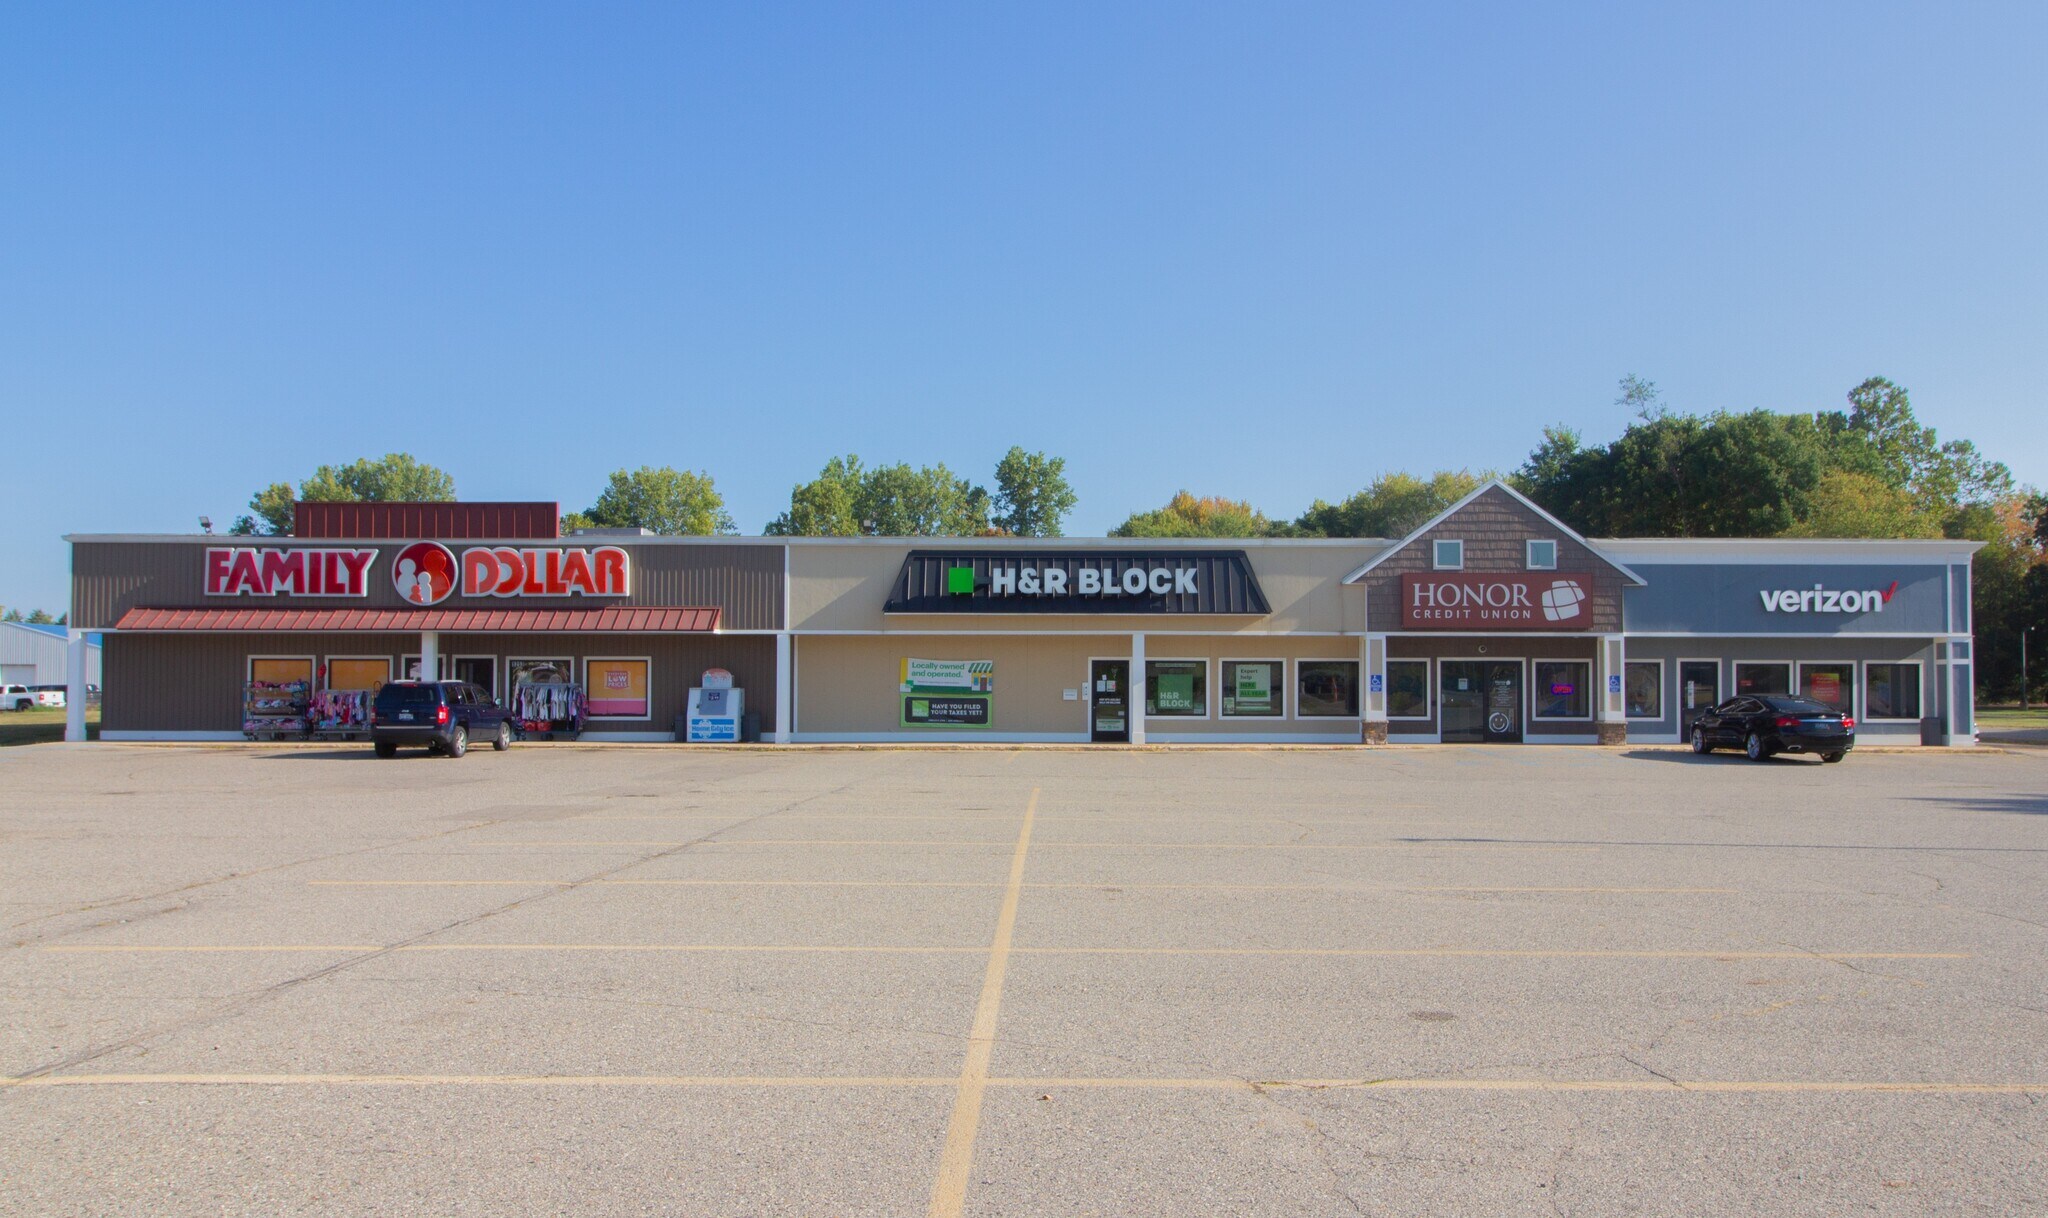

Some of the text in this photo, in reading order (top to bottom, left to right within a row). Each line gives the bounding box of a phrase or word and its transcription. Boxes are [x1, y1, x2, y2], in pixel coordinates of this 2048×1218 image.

[207, 549, 627, 594] FAMILY DOLLAR
[992, 567, 1198, 594] H&R BLOCK
[1413, 584, 1532, 607] HONOR
[1760, 584, 1883, 613] verizon
[1413, 609, 1531, 619] CREDIT UNION
[912, 662, 938, 670] Locally
[927, 671, 963, 679] operated.
[1160, 692, 1179, 700] H&R
[1160, 700, 1191, 708] BLOCK
